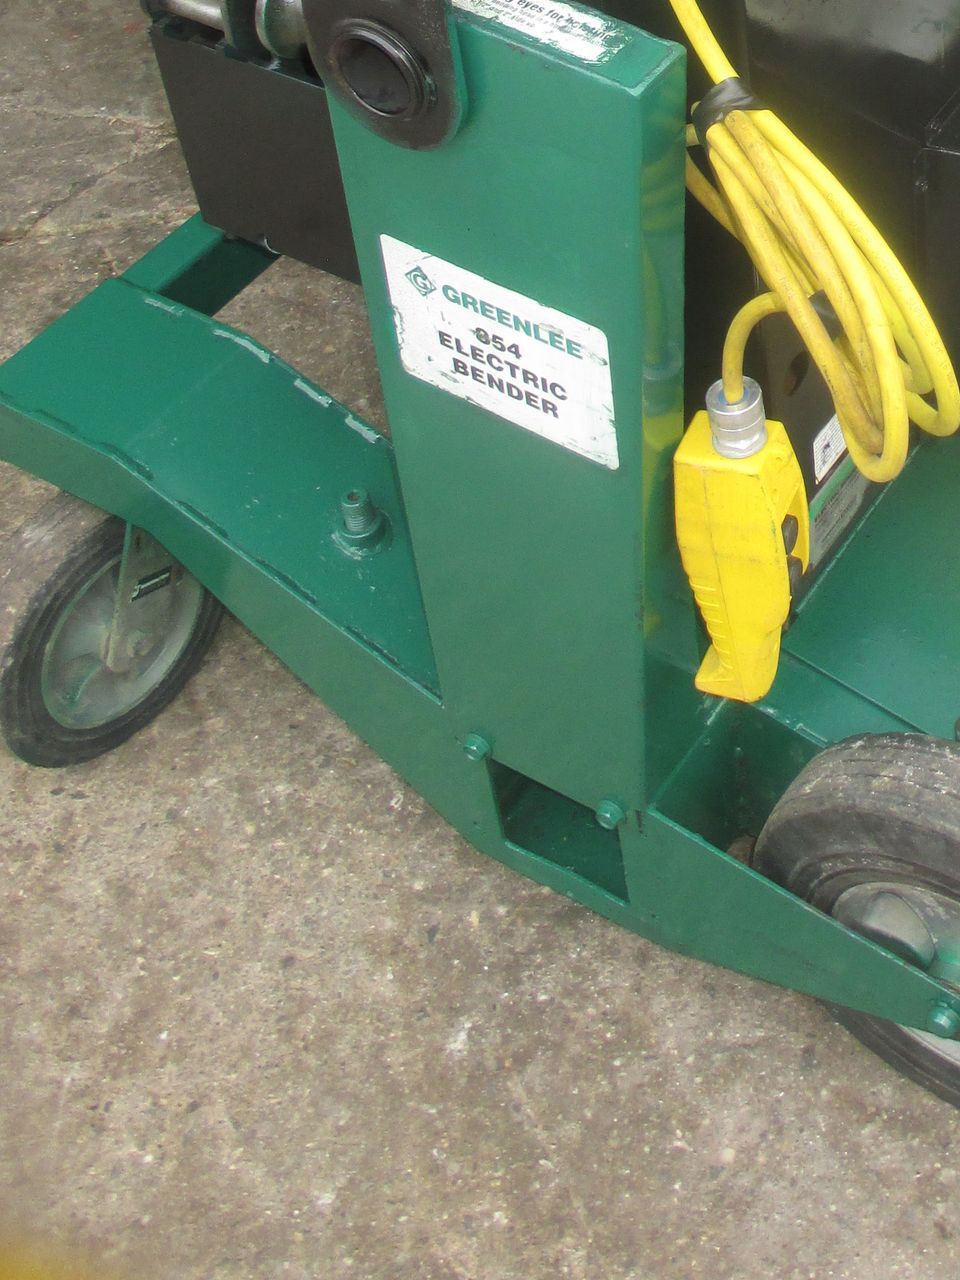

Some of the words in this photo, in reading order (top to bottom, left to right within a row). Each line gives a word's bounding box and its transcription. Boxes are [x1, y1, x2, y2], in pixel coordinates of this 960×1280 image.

[517, 0, 545, 13] eyes
[545, 9, 564, 22] for
[442, 284, 583, 360] GREENLEE
[474, 327, 522, 360] 854
[438, 330, 568, 401] ELECTRIC
[453, 357, 559, 419] BENDER
